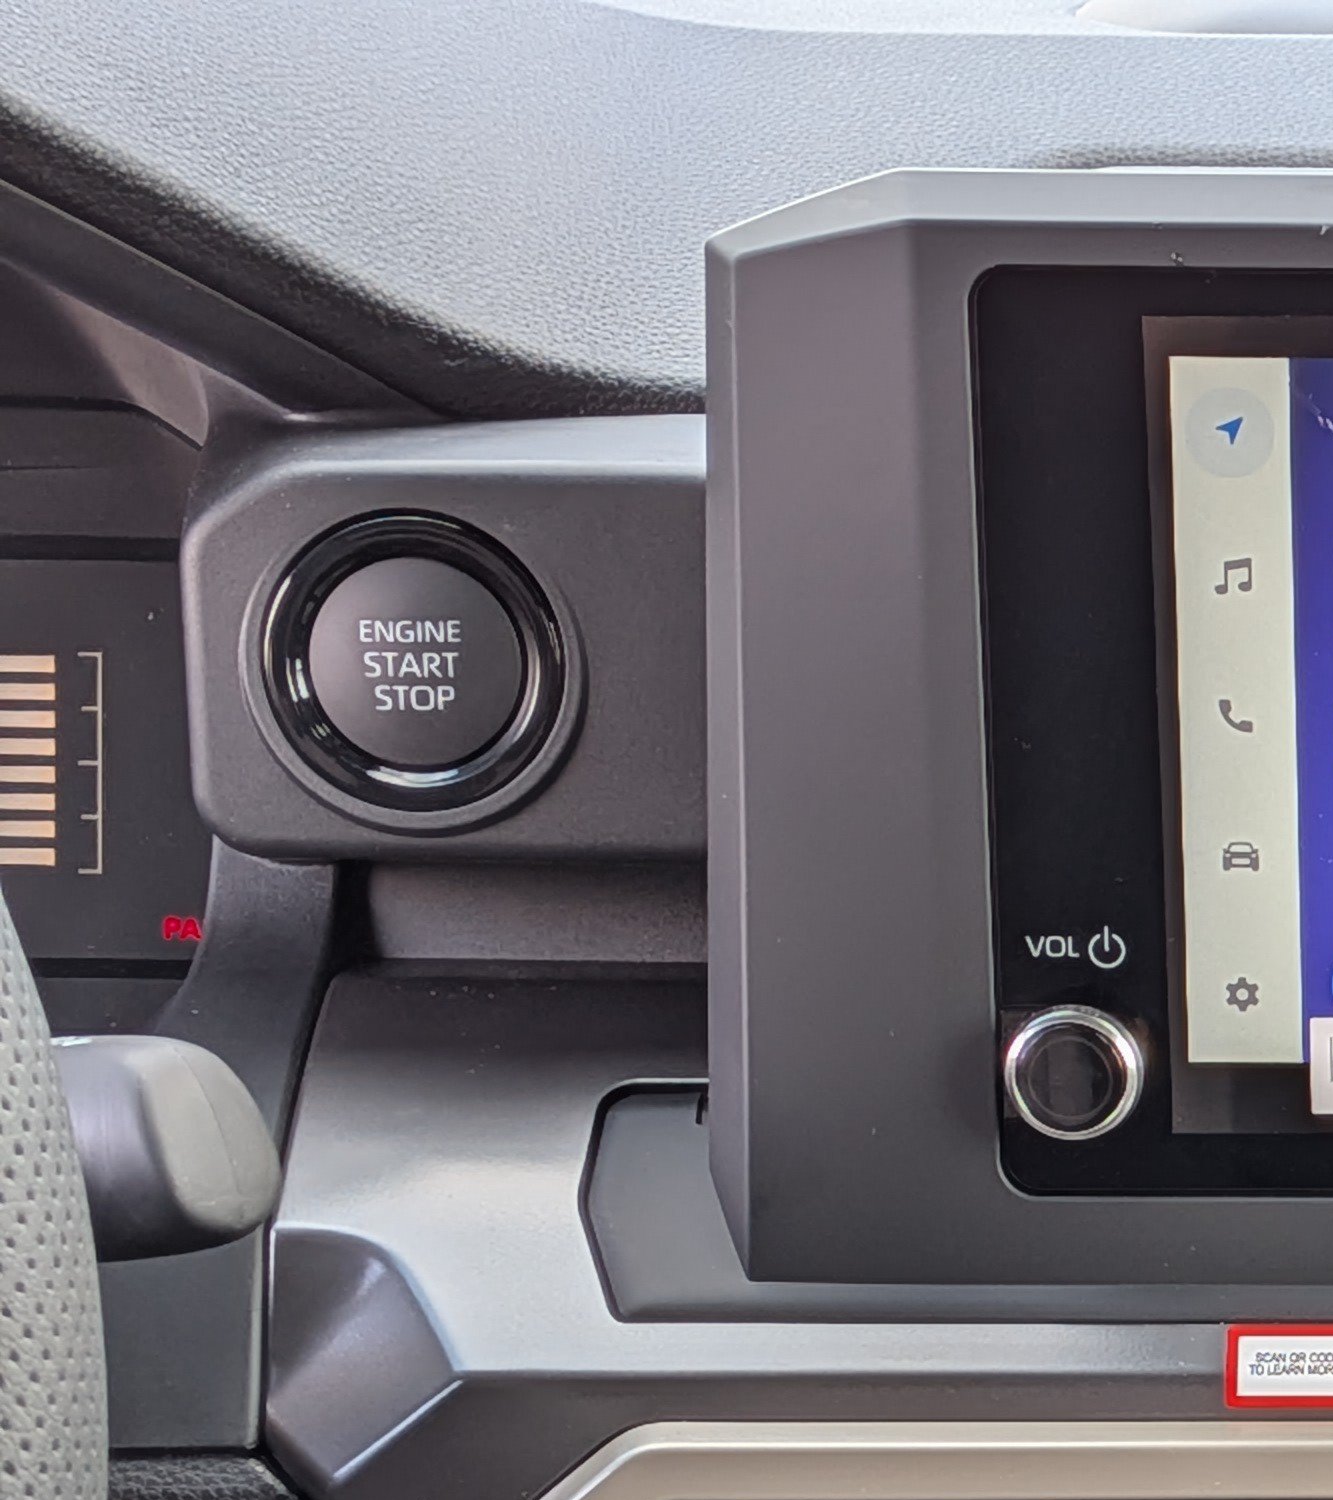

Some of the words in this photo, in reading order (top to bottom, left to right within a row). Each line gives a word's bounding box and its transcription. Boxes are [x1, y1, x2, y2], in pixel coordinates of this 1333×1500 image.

[359, 619, 462, 643] ENGINE
[363, 651, 459, 678] START
[374, 684, 455, 711] STOP
[163, 916, 202, 941] PA
[1025, 935, 1080, 958] VOL
[1255, 1352, 1286, 1363] SCAN
[1249, 1364, 1264, 1377] TO
[1266, 1364, 1305, 1377] LEARN
